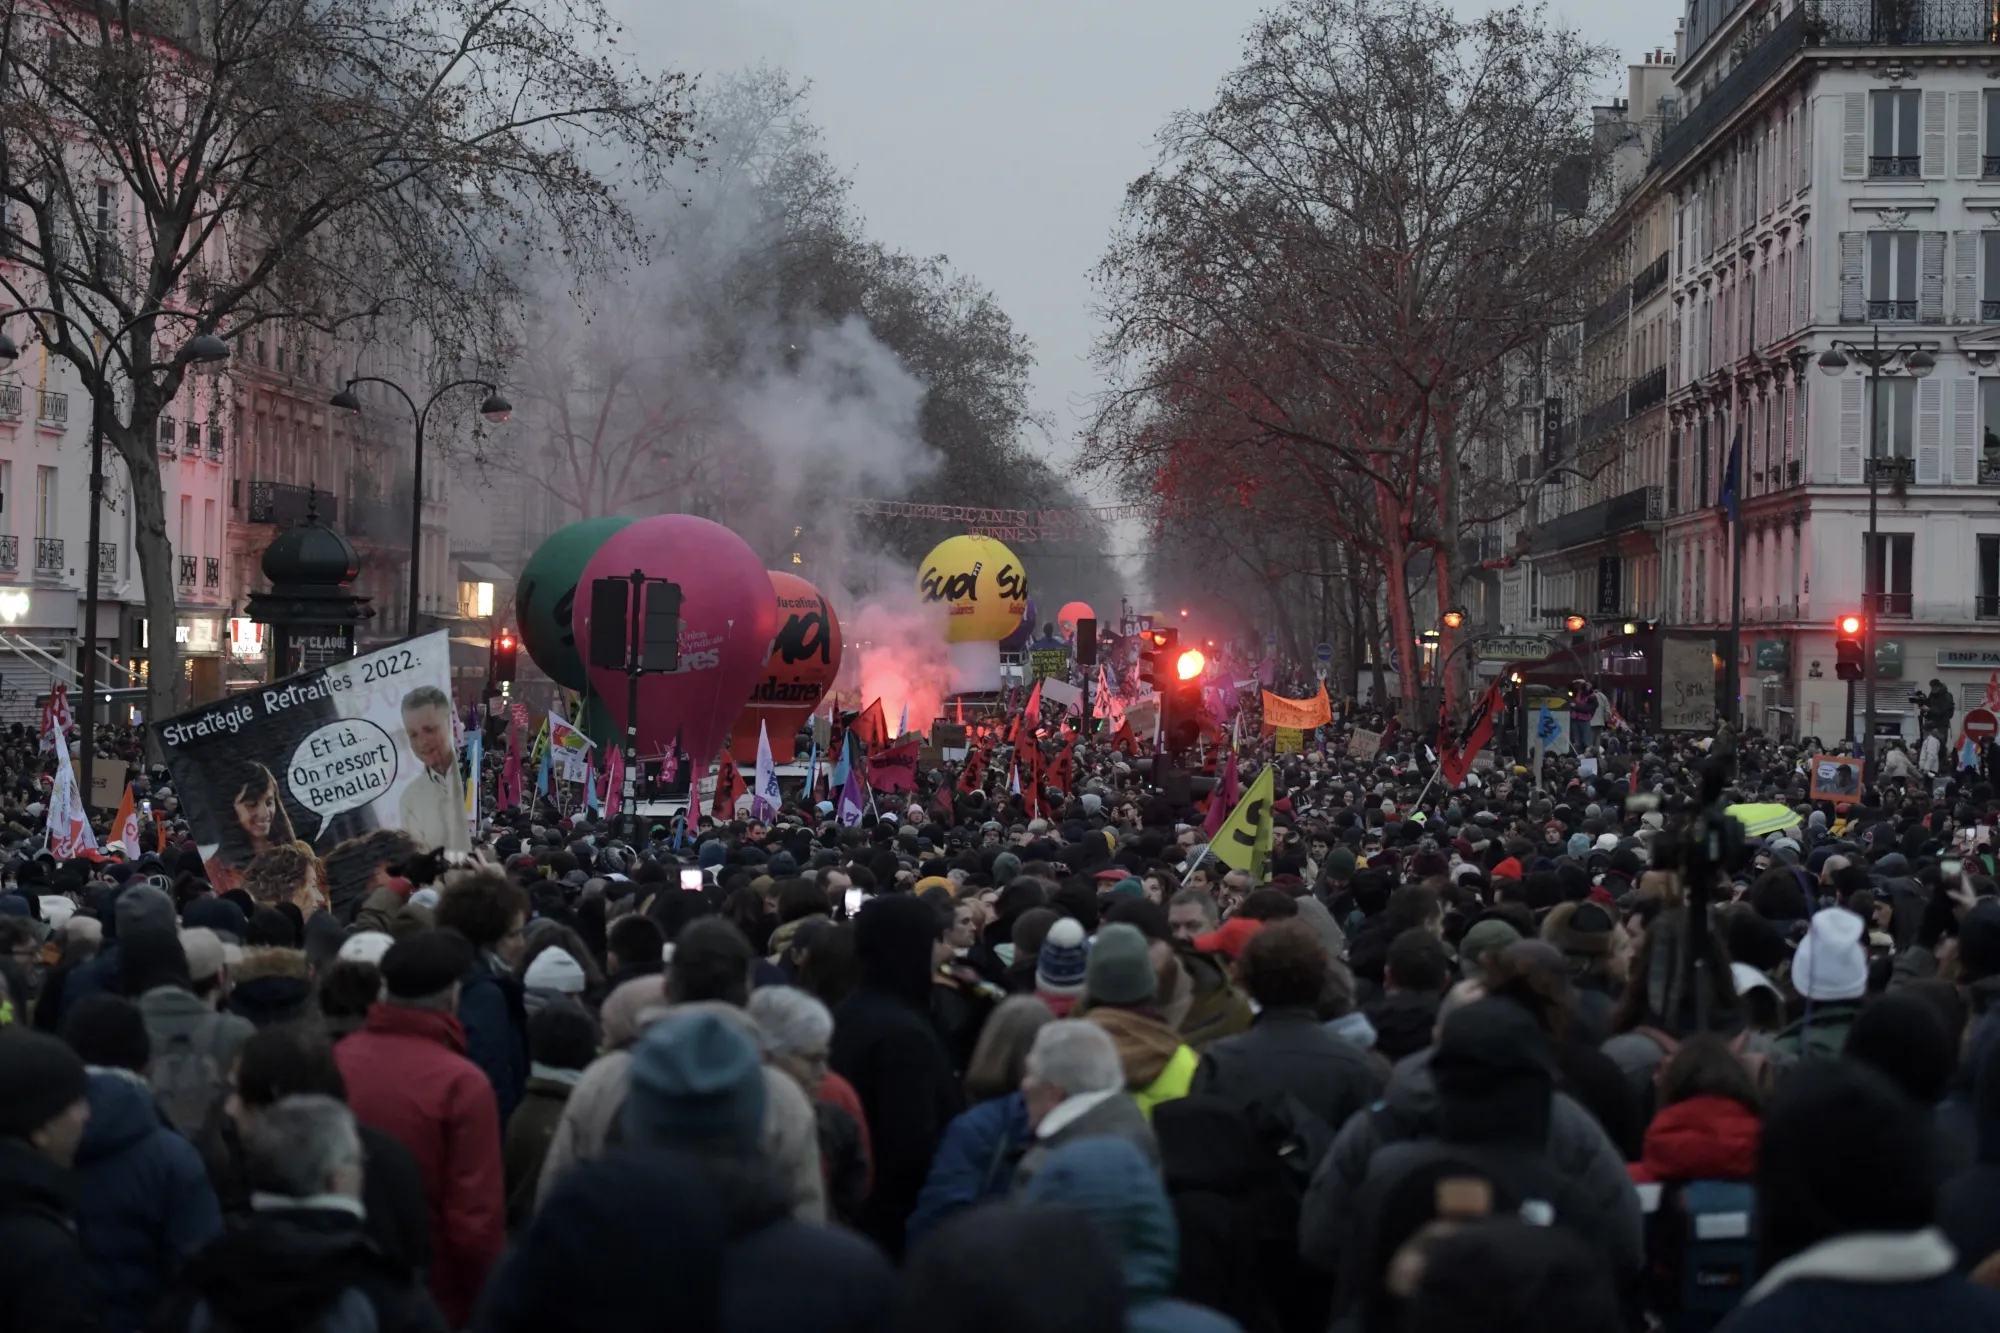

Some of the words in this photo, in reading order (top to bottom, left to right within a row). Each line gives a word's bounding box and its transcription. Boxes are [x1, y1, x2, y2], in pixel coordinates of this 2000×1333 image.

[678, 629, 707, 641] Union
[680, 635, 724, 652] Syndicale
[1481, 640, 1547, 655] METROPOLITAIN
[1948, 651, 1978, 661] BNP
[163, 705, 254, 746] Stratégie
[262, 672, 352, 715] Retraites
[310, 739, 330, 758] Et
[293, 768, 319, 786] On
[328, 744, 389, 777] ressort
[309, 768, 387, 807] Benalla!
